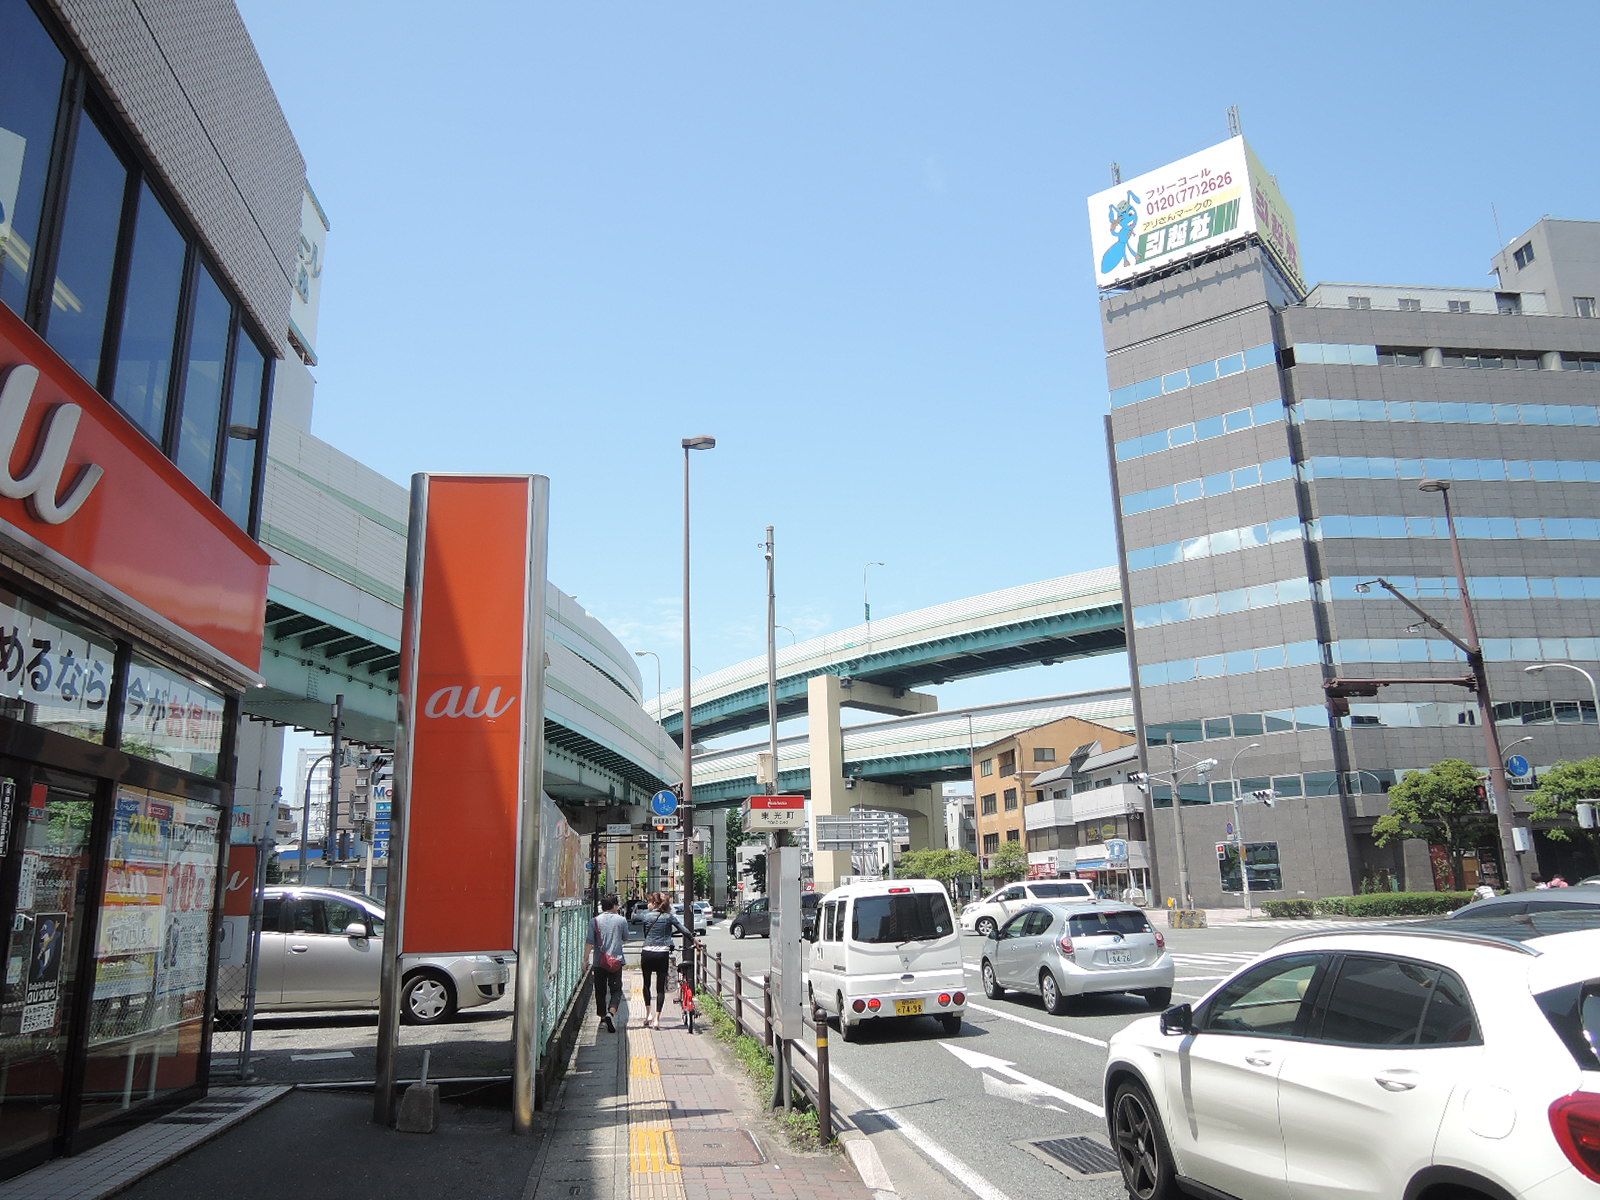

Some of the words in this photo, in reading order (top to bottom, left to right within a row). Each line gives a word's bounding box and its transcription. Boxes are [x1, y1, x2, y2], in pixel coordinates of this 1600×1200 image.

[1145, 168, 1211, 200] フリーコール
[1146, 171, 1233, 216] 0120(77)2626
[1142, 198, 1213, 231] アリさんマークの
[424, 685, 516, 719] au
[761, 811, 795, 820] 東光町
